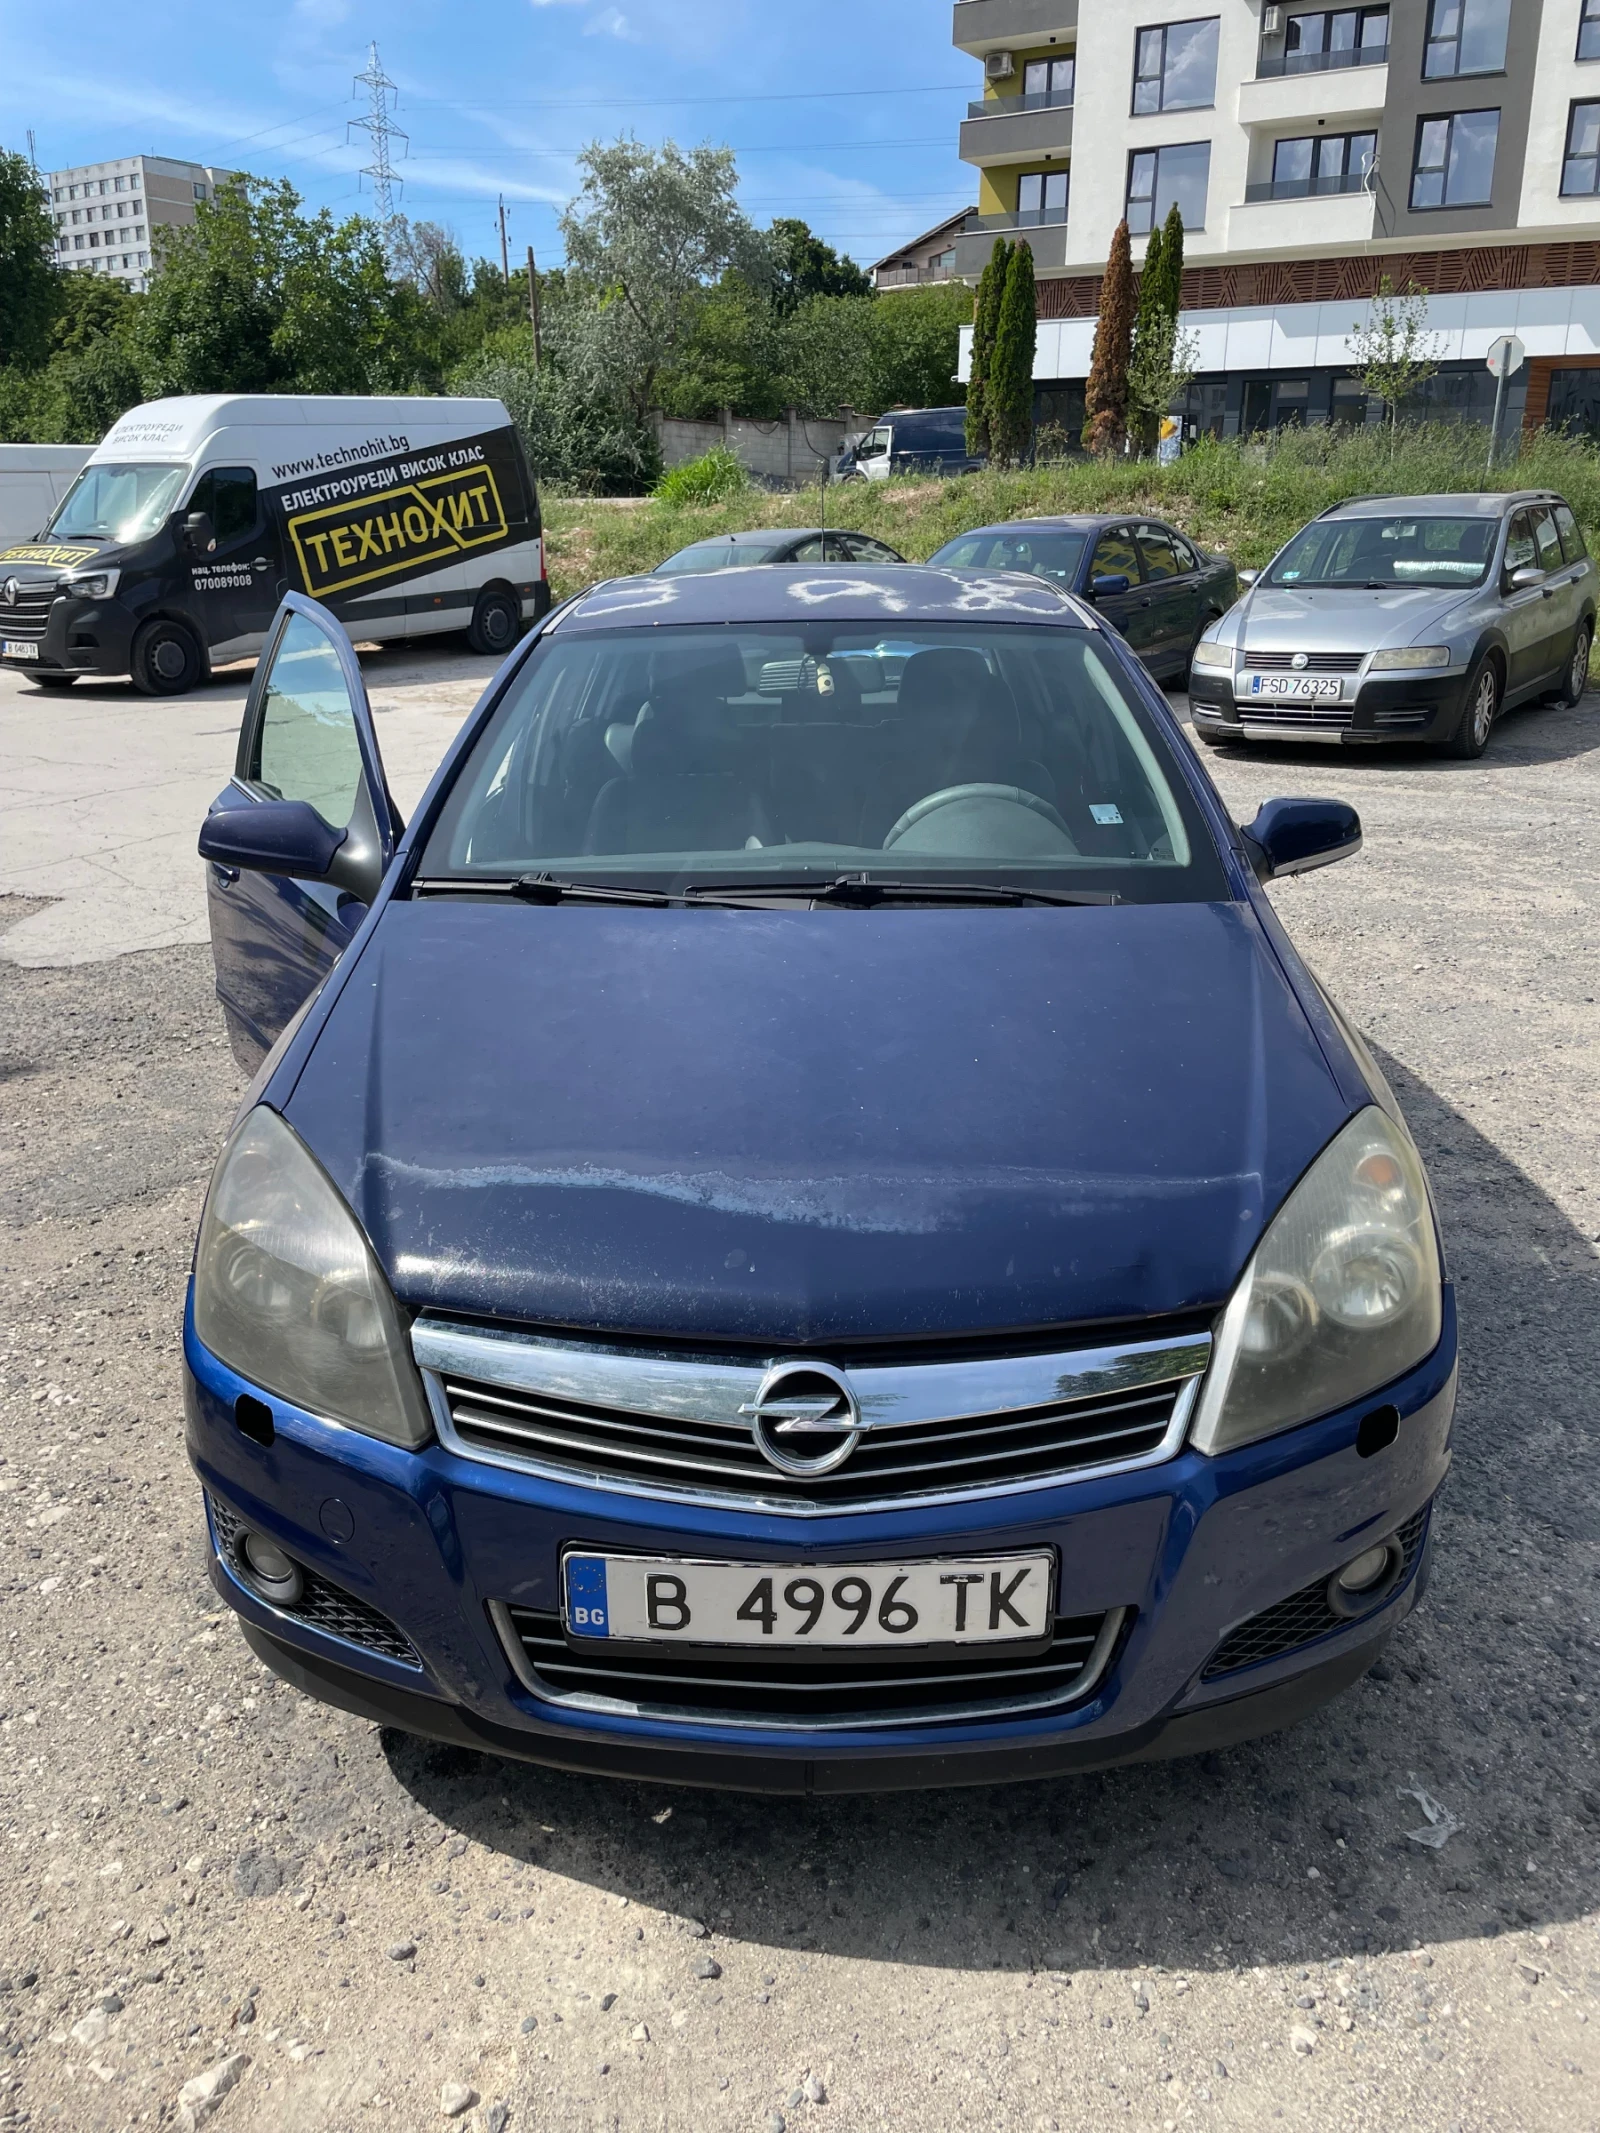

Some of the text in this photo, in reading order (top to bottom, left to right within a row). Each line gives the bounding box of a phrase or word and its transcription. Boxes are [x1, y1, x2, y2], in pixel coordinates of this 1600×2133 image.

[114, 423, 184, 435] ЕЛЕКТРОУРЕДИ
[140, 433, 169, 443] КЛАС
[272, 435, 411, 479] www.technohit.bg
[281, 445, 486, 512] ЕЛЕКТРОУРЕДИ ВИСОК КЛАС
[305, 485, 490, 573] ТЕХНОХИТ
[211, 562, 251, 574] телефон:
[194, 574, 253, 591] 070089008
[1260, 678, 1289, 694] FSD
[1292, 679, 1339, 695] 76325
[646, 1568, 1032, 1635] B 4996 TK
[575, 1606, 605, 1625] BG
